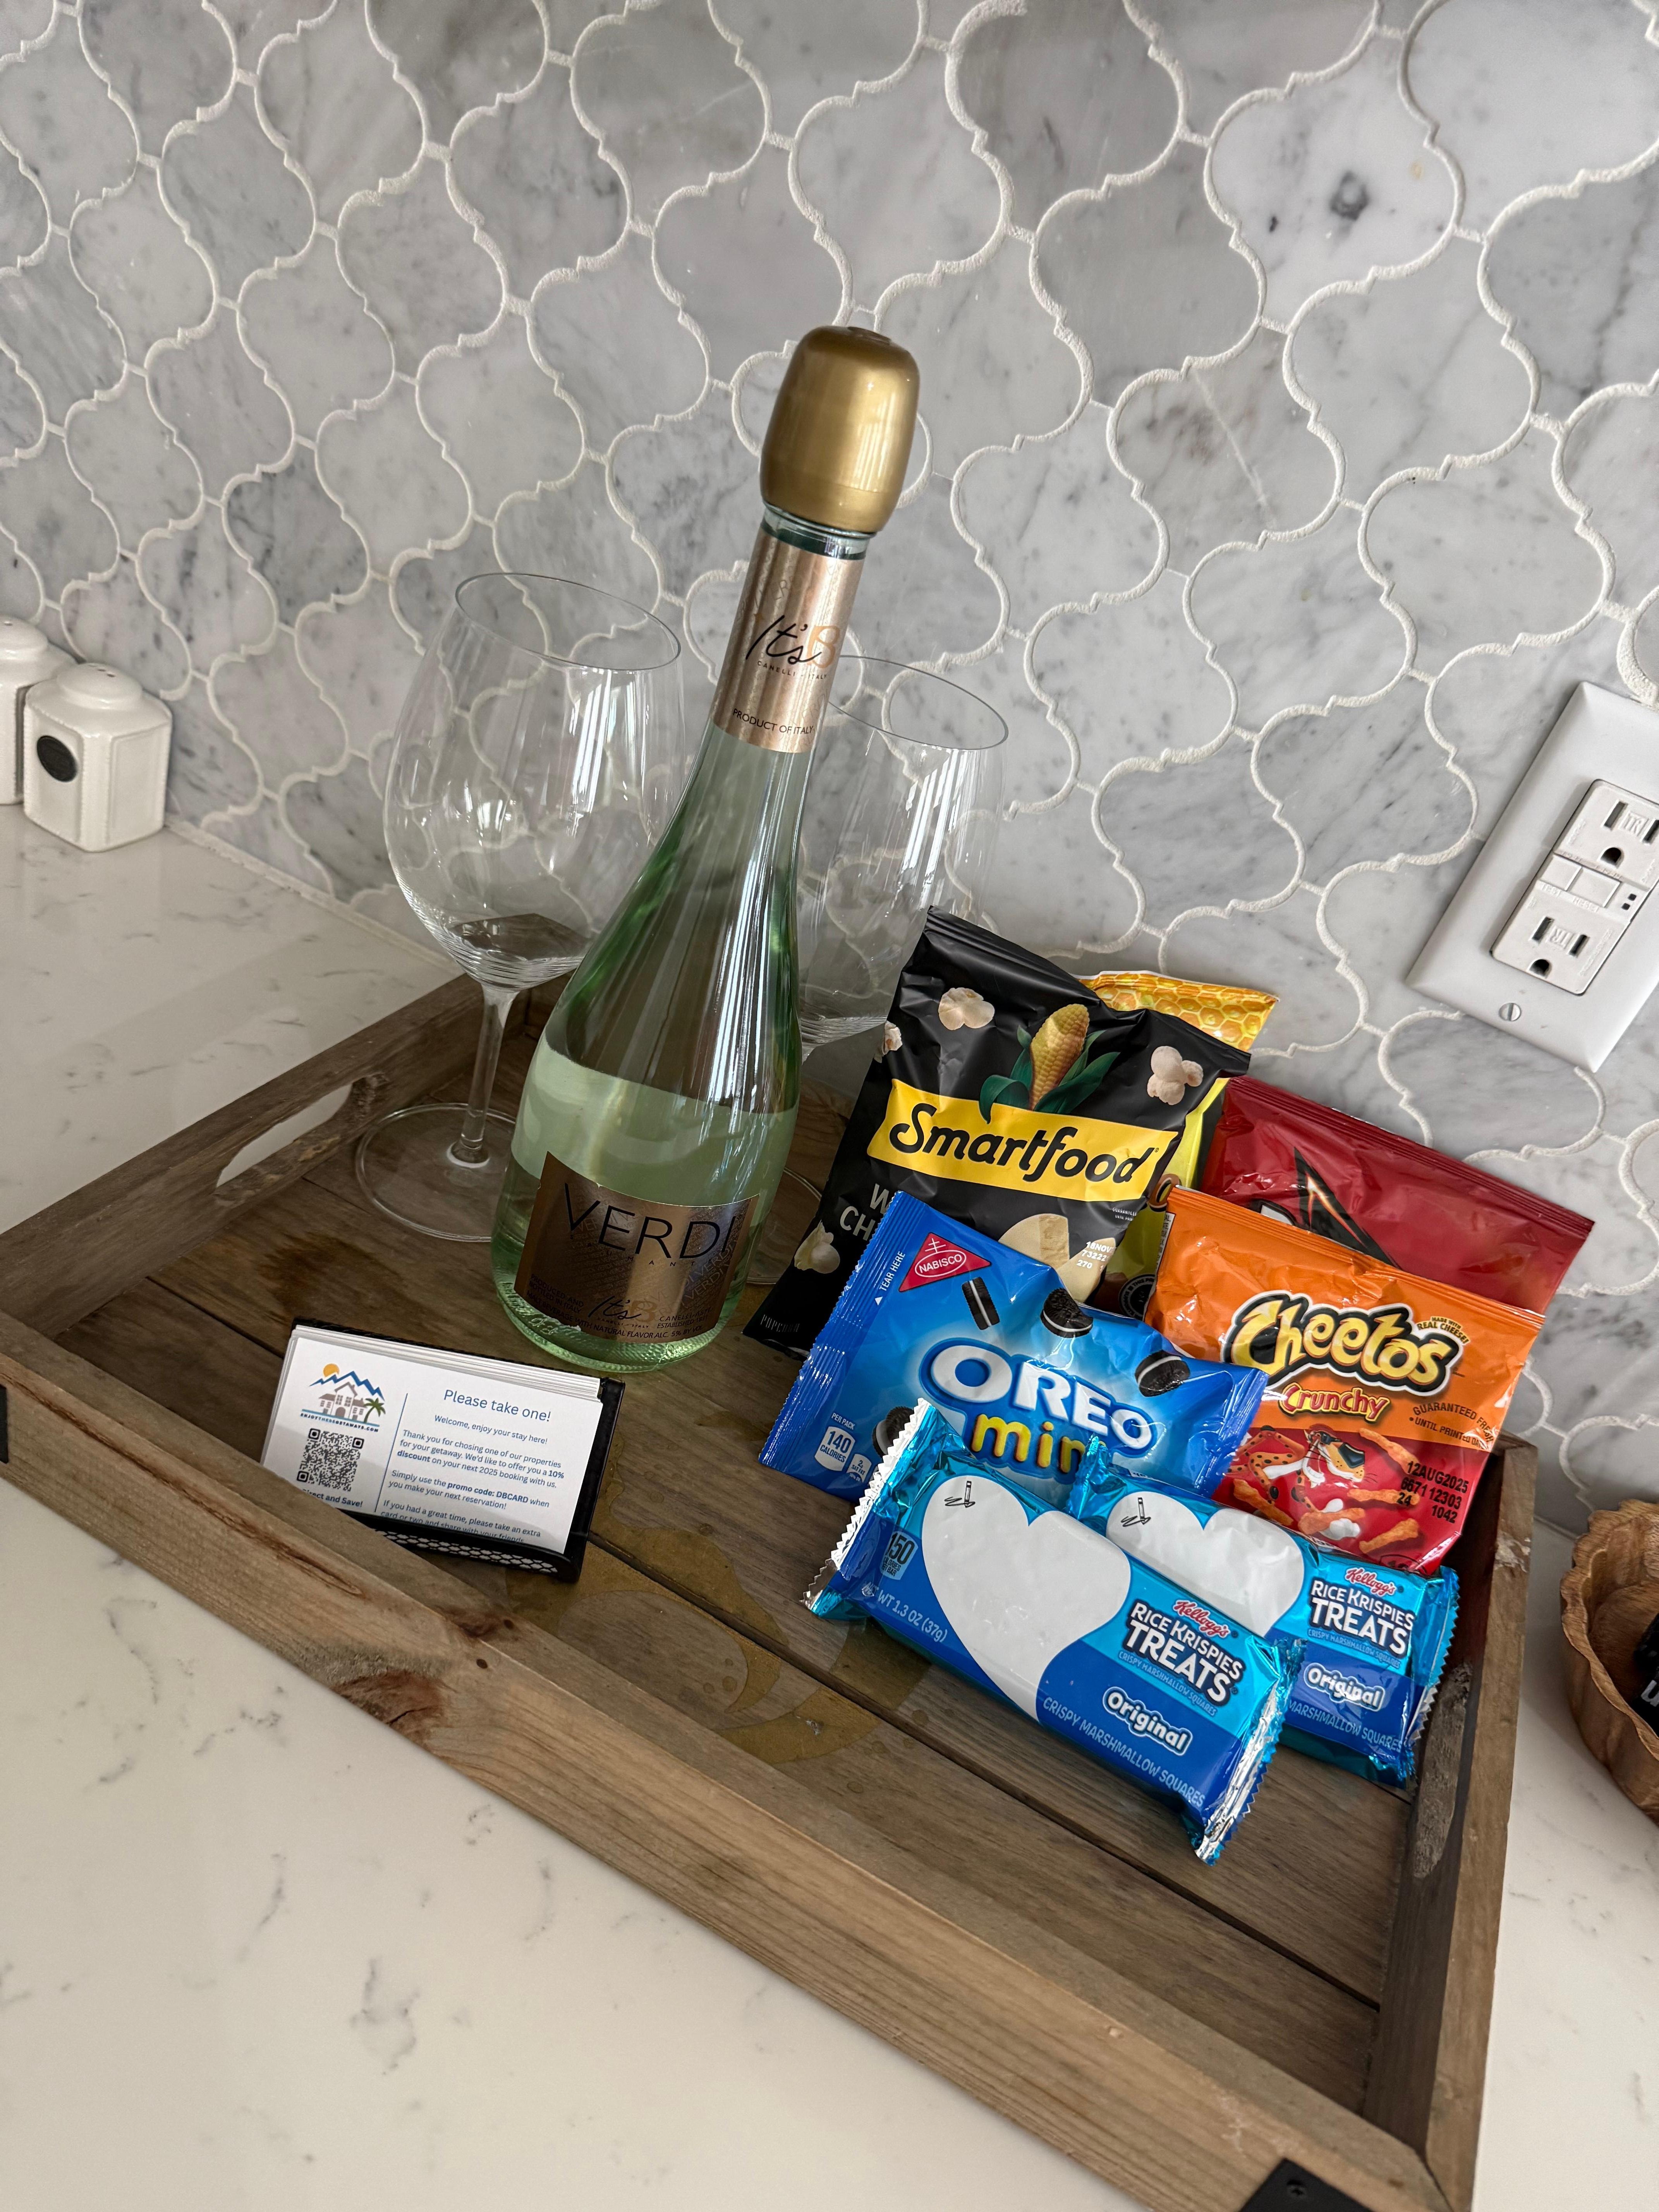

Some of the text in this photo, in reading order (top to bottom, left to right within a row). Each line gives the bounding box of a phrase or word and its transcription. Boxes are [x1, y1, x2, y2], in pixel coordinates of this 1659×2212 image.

[745, 615, 822, 665] It's
[757, 660, 796, 677] CANELLI
[733, 708, 814, 735] PRODUCT OF ITALY
[889, 1103, 1155, 1183] Smartfood
[564, 1183, 736, 1259] VERDI
[879, 1250, 906, 1291] TEAR HERE
[919, 1254, 962, 1274] NABISCO
[1076, 1259, 1093, 1269] 270
[555, 1297, 562, 1306] IN
[563, 1302, 582, 1314] ITALY
[568, 1297, 584, 1307] AND
[588, 1295, 642, 1320] It's
[575, 1317, 593, 1329] WITH
[593, 1322, 625, 1336] NATURAL
[1416, 1321, 1469, 1344] REAL CHEESE!
[1448, 1319, 1462, 1329] WITH
[1228, 1297, 1454, 1387] Cheetos
[444, 1389, 551, 1422] Please take one!
[931, 1345, 1153, 1449] OREO
[1283, 1384, 1391, 1422] Crunchy
[1413, 1402, 1477, 1420] GUARANTEED
[434, 1415, 548, 1444] Welcome, enjoy your stay here!
[831, 1413, 855, 1430] PER PACK
[1415, 1417, 1470, 1443] UNTIL PRINTED
[403, 1429, 425, 1440] Thank
[426, 1435, 441, 1443] you
[442, 1437, 453, 1446] for
[454, 1441, 484, 1454] chosing
[510, 1452, 522, 1460] our
[523, 1456, 561, 1468] properties
[819, 1444, 846, 1463] CALORIES
[827, 1431, 852, 1453] 140
[972, 1414, 1100, 1474] min
[397, 1450, 431, 1462] discount
[443, 1460, 461, 1468] your
[461, 1464, 479, 1472] next
[480, 1466, 498, 1476] 2025
[499, 1470, 528, 1484] booking
[530, 1477, 546, 1486] with
[400, 1439, 412, 1448] for
[412, 1443, 430, 1451] your
[431, 1446, 463, 1460] getaway.
[465, 1452, 483, 1463] We'd
[484, 1457, 497, 1466] like
[508, 1462, 527, 1471] offer
[527, 1467, 541, 1475] you
[548, 1470, 565, 1479] 10%
[392, 1470, 418, 1482] Simply
[434, 1479, 446, 1487] the
[447, 1482, 473, 1492] promo
[472, 1487, 495, 1497] code:
[496, 1491, 529, 1503] DBCARD
[530, 1498, 550, 1508] when
[1401, 1477, 1462, 1510] 6671 12303
[1408, 1460, 1469, 1494] 12AUG2025
[341, 1497, 363, 1507] Save!
[404, 1484, 424, 1493] make
[425, 1488, 444, 1496] your
[445, 1492, 461, 1501] next
[462, 1496, 507, 1510] reservation!
[1396, 1492, 1458, 1524] 24 1042
[406, 1504, 421, 1513] had
[427, 1510, 448, 1519] great
[449, 1513, 467, 1524] time,
[468, 1518, 493, 1528] please
[495, 1522, 510, 1531] take
[885, 1532, 915, 1565] 150
[888, 1566, 897, 1577] BAR
[1346, 1568, 1396, 1596] Kellogg's
[878, 1589, 948, 1643] WT 1.3 OZ (37g)
[1173, 1600, 1229, 1638] Kellogg's
[1311, 1580, 1415, 1631] RICE KRISPIES
[1130, 1602, 1243, 1680] RICE KRISPIES
[1311, 1597, 1409, 1655] TREATS
[1126, 1620, 1231, 1702] TREATS
[1308, 1629, 1401, 1668] CRISPY MARSHMALLOW SQUARES
[1118, 1651, 1217, 1716] CRISPY MARSHMALLOW SQUARES
[1307, 1667, 1382, 1708] Original
[1107, 1692, 1188, 1750] Original
[1288, 1700, 1403, 1753] MARSHMALLOW SQUARES
[1043, 1696, 1206, 1808] CRISPY MARSHMALLOW SQUARES
